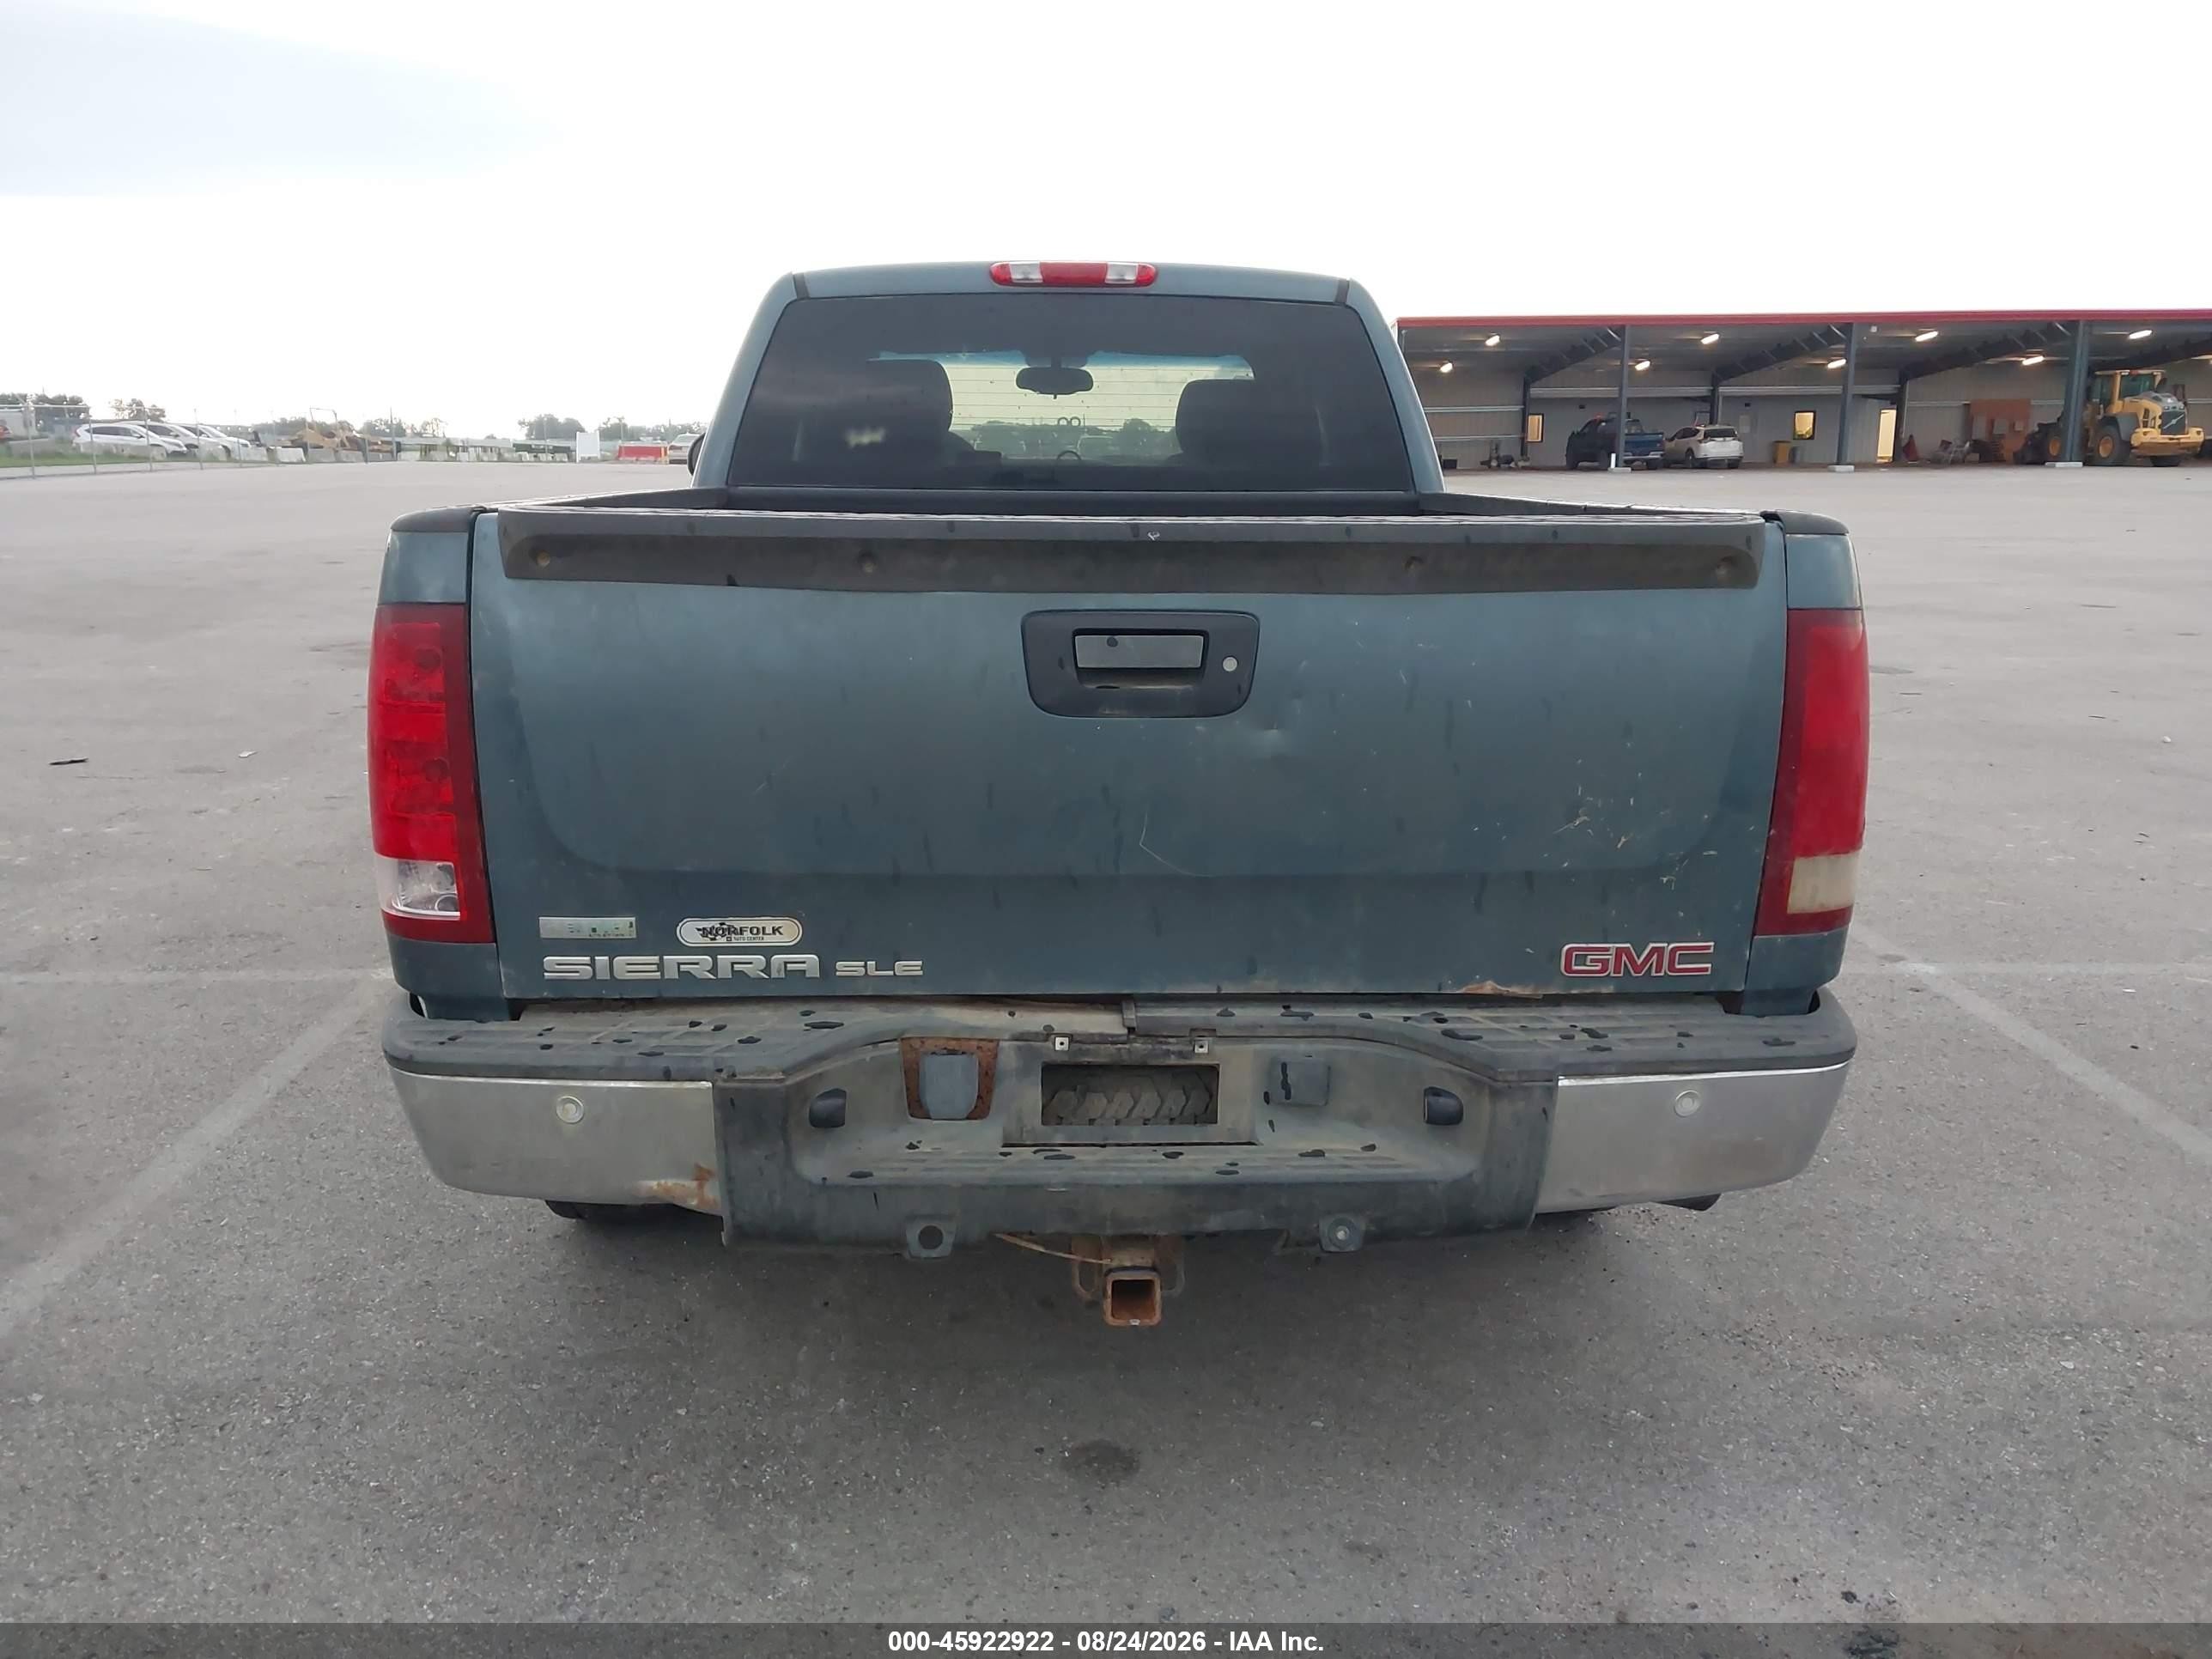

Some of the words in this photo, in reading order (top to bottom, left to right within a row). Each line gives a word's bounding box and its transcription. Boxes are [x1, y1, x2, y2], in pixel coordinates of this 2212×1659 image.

[702, 926, 783, 937] NORFOLK
[543, 954, 820, 980] SIERRA
[835, 960, 923, 976] SLE
[1561, 942, 1715, 976] GMC
